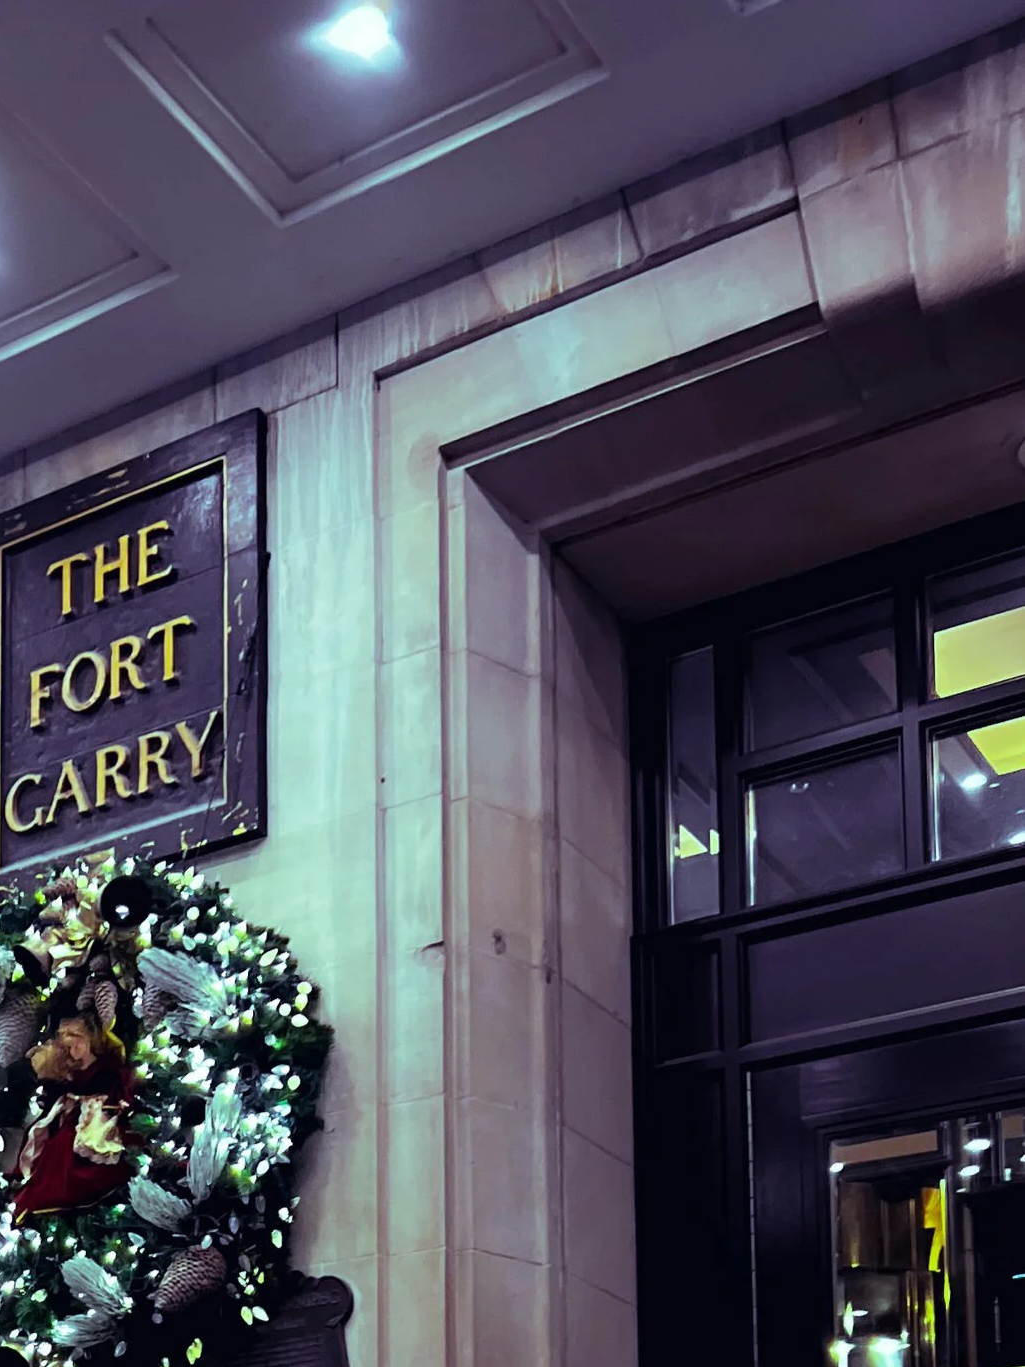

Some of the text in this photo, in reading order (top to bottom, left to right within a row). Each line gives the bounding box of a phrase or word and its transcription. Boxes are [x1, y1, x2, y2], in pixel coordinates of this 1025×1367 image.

[47, 519, 173, 616] THE
[29, 614, 194, 728] FORT
[4, 710, 218, 833] GARRY
